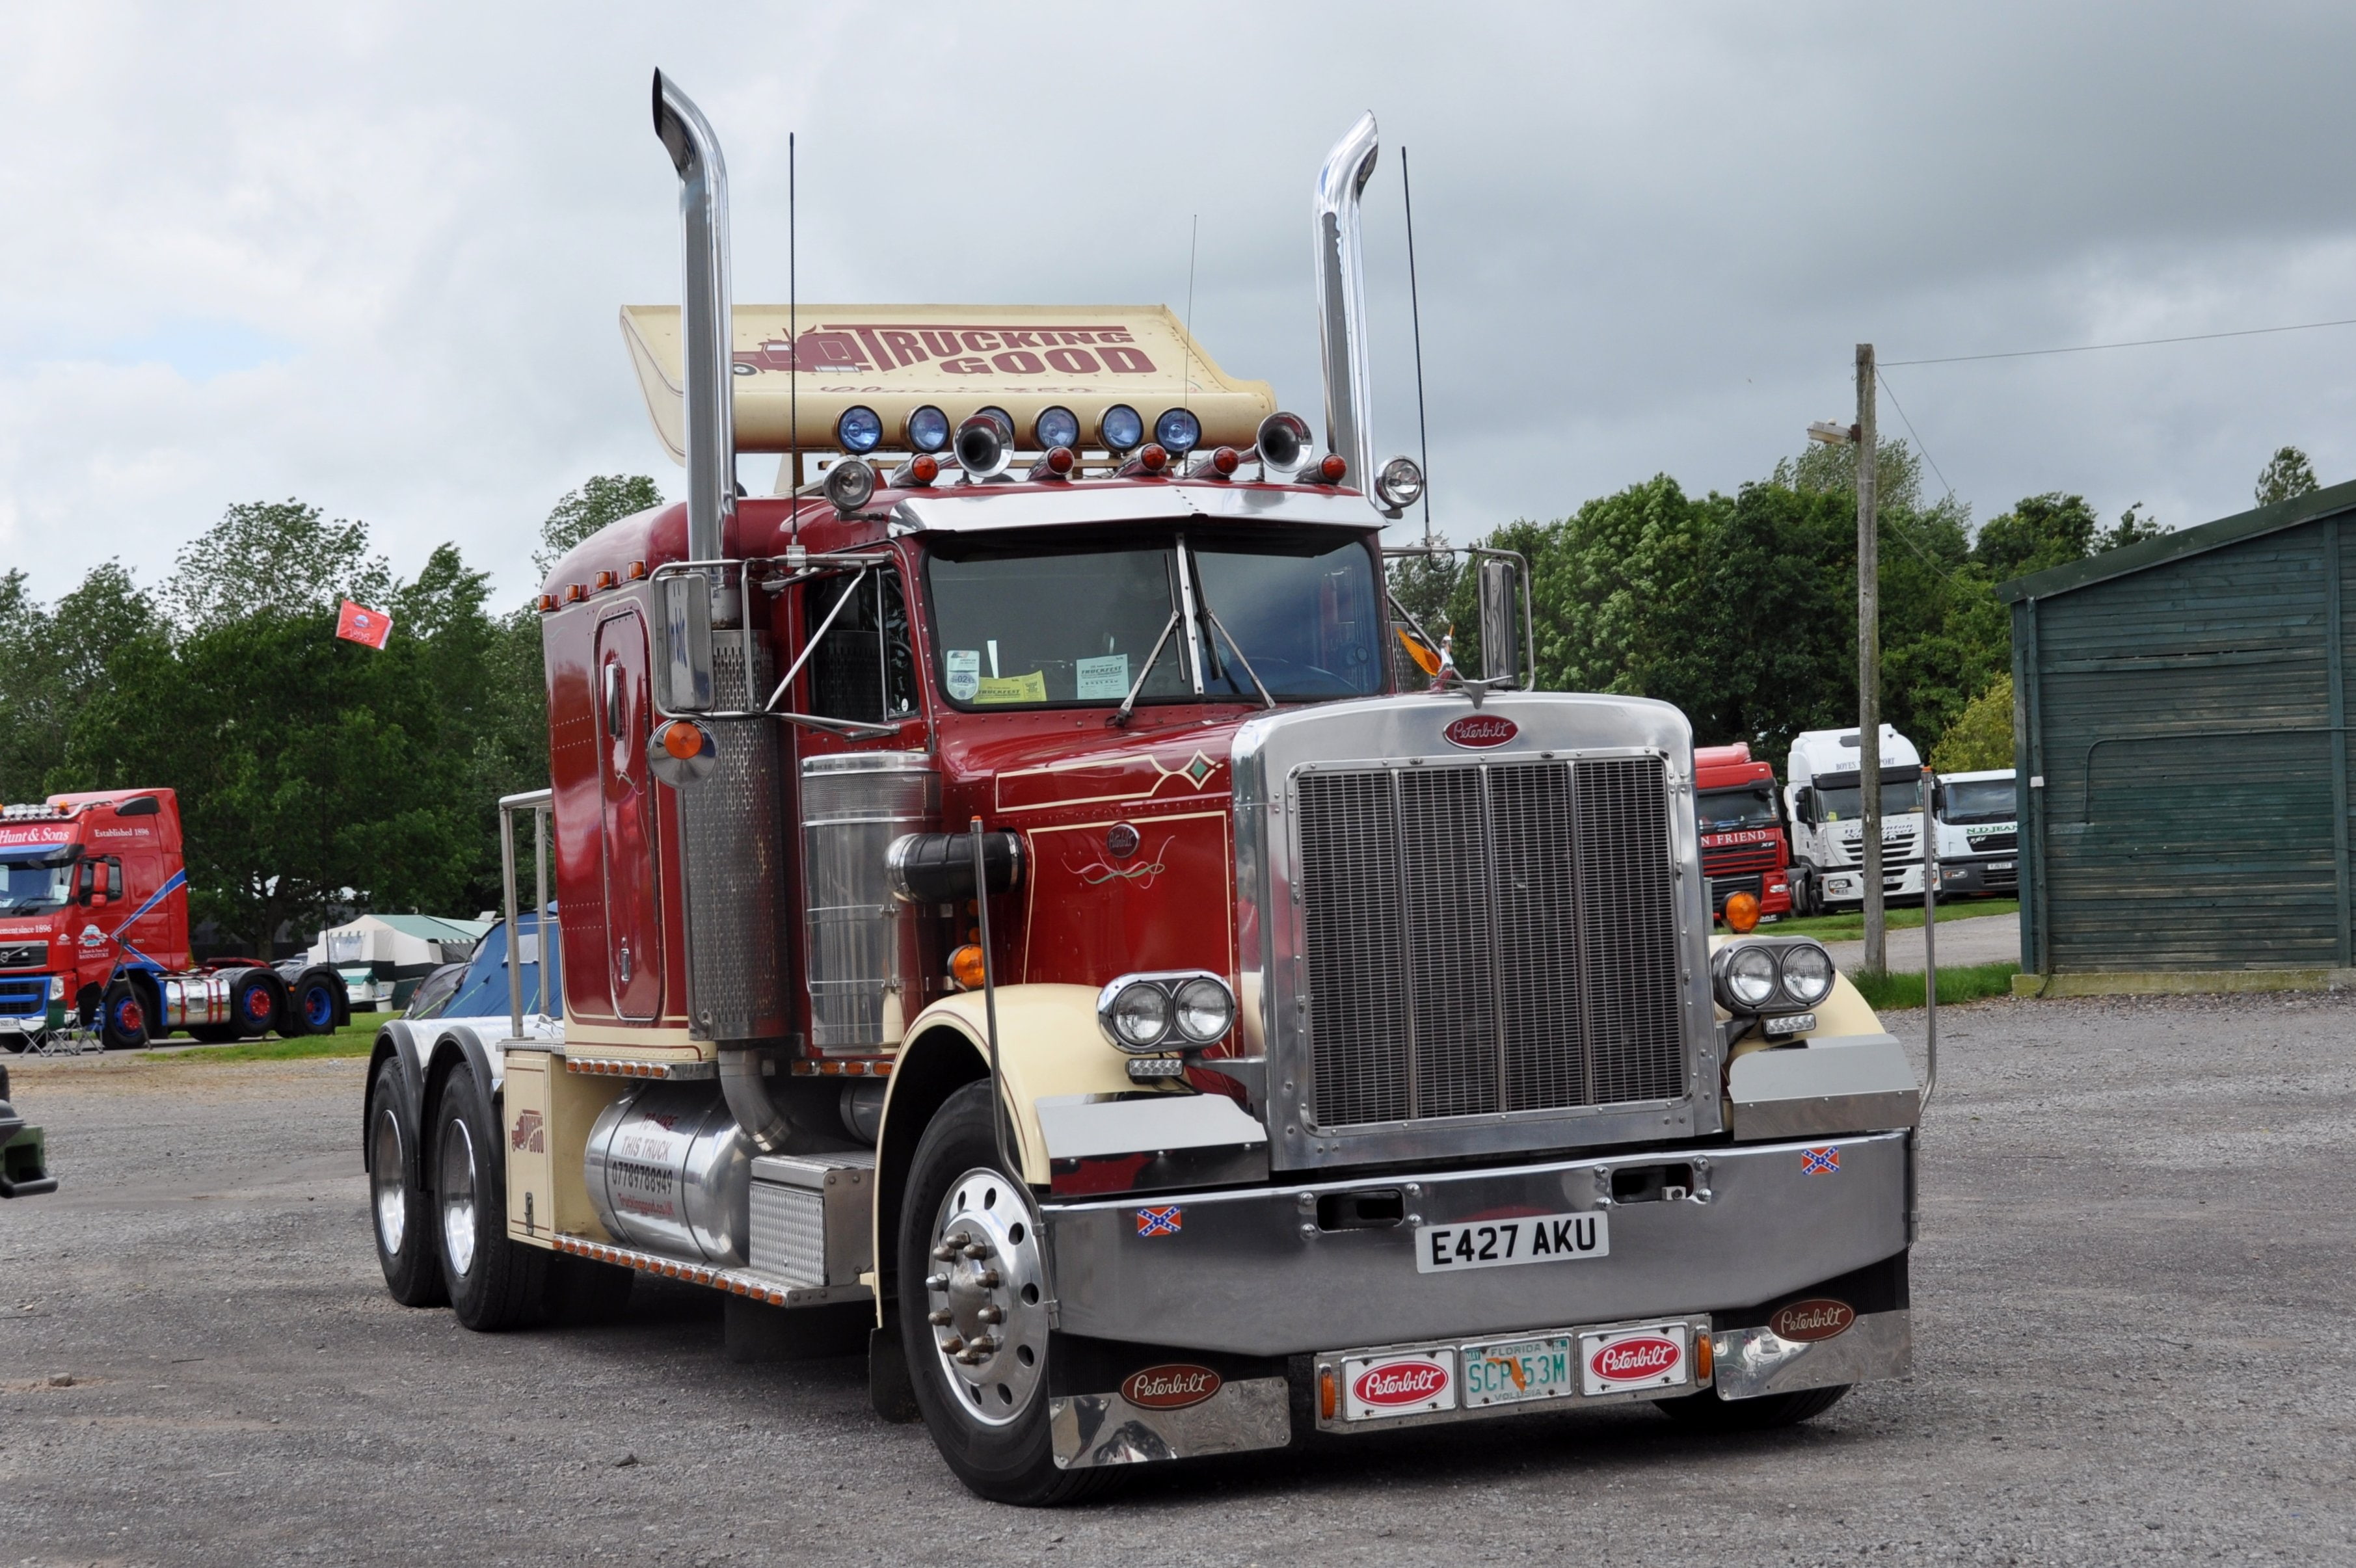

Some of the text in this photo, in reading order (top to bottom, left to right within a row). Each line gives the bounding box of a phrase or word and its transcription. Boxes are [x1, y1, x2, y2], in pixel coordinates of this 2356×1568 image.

[822, 325, 1134, 372] TRUCKING
[939, 347, 1157, 374] GOOD
[1453, 721, 1512, 739] Peterbilt
[1836, 762, 1856, 771] BOYES
[0, 827, 70, 844] Hunt & Sons
[94, 829, 133, 837] Established
[1717, 831, 1766, 844] FRIEND
[639, 1113, 678, 1133] TO HIRE
[529, 1129, 544, 1154] GOOD
[621, 1136, 673, 1162] THIS TRUCK
[612, 1160, 673, 1195] 07789788949
[1432, 1217, 1596, 1265] E427 AKU
[1781, 1307, 1845, 1335] Peterbilt
[1466, 1351, 1480, 1361] MAY
[1491, 1344, 1542, 1356] FLORIDA
[1601, 1345, 1674, 1374] Peterbilt
[1134, 1373, 1212, 1398] Peterbilt
[1366, 1369, 1441, 1400] Peterbilt
[1469, 1353, 1565, 1393] SCP 53M
[1494, 1389, 1542, 1401] VOLUSIA
